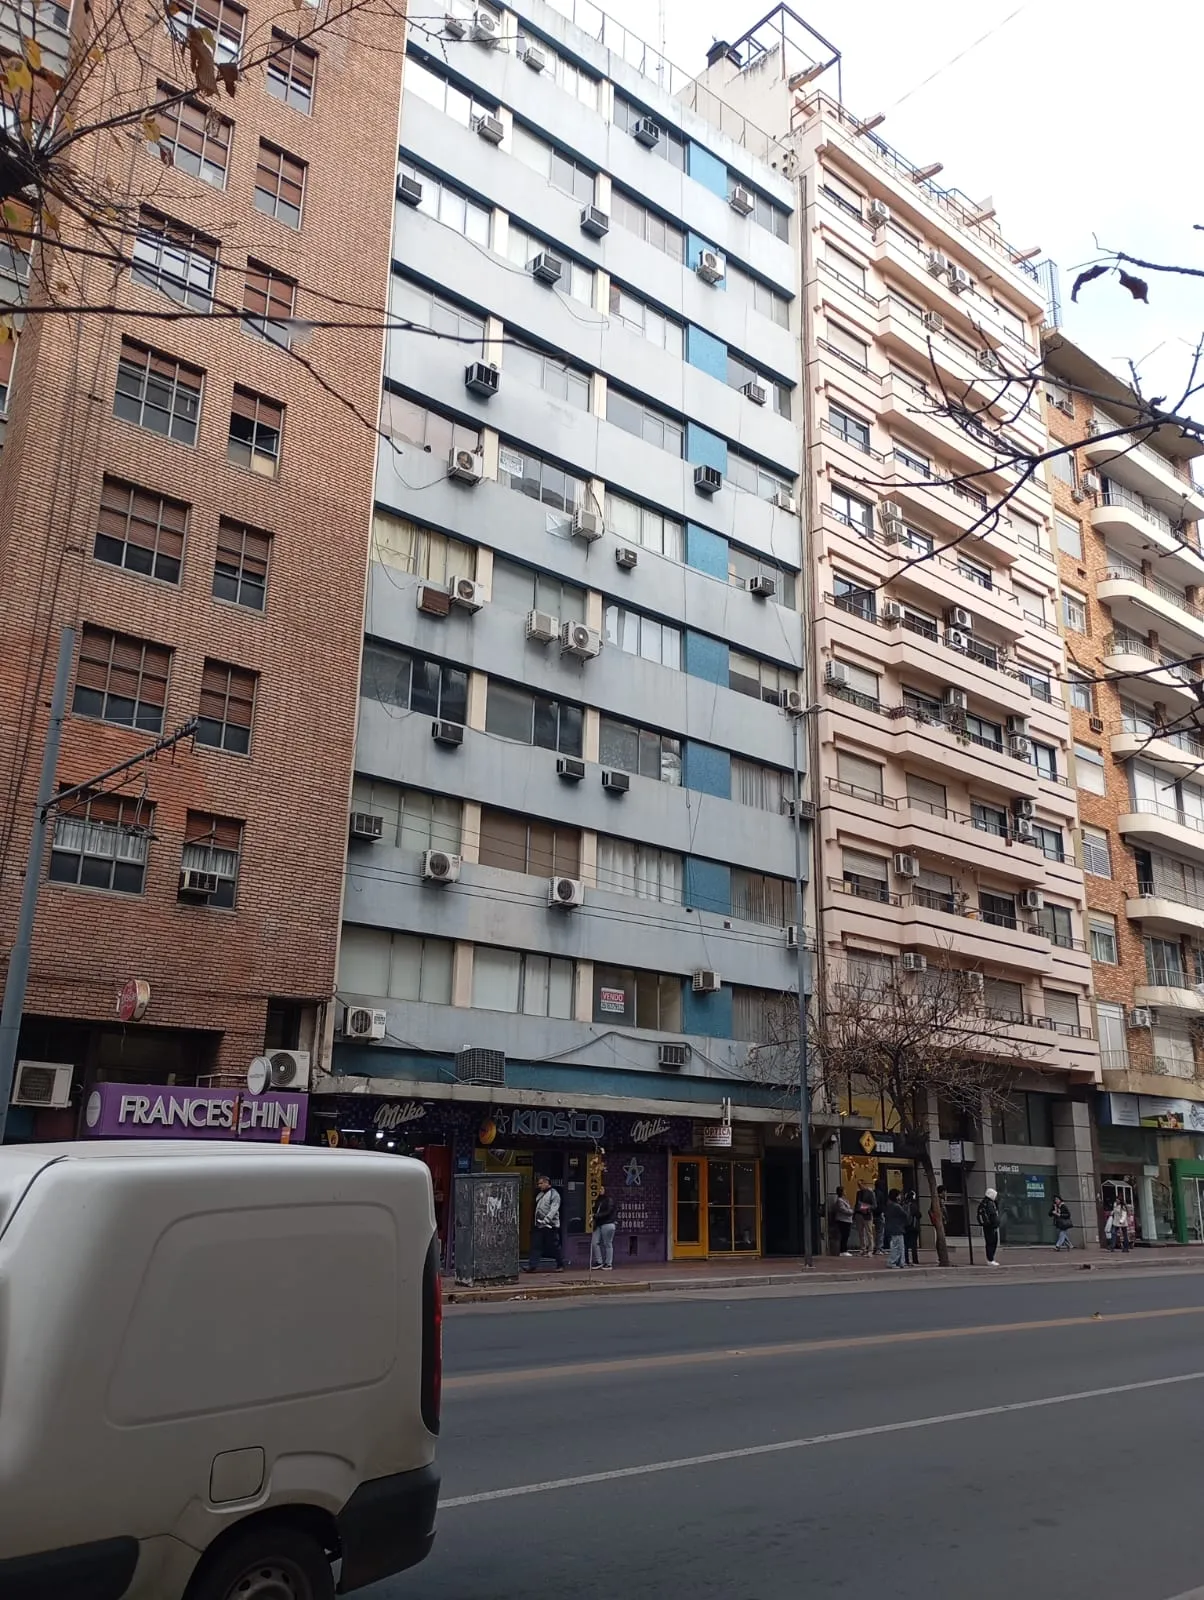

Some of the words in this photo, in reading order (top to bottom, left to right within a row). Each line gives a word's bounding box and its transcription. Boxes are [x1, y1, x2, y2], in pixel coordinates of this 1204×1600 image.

[602, 991, 623, 1001] VENDO
[118, 1095, 299, 1129] FRANCESCHINI
[373, 1101, 426, 1129] Milka
[511, 1109, 605, 1138] KIOSCO
